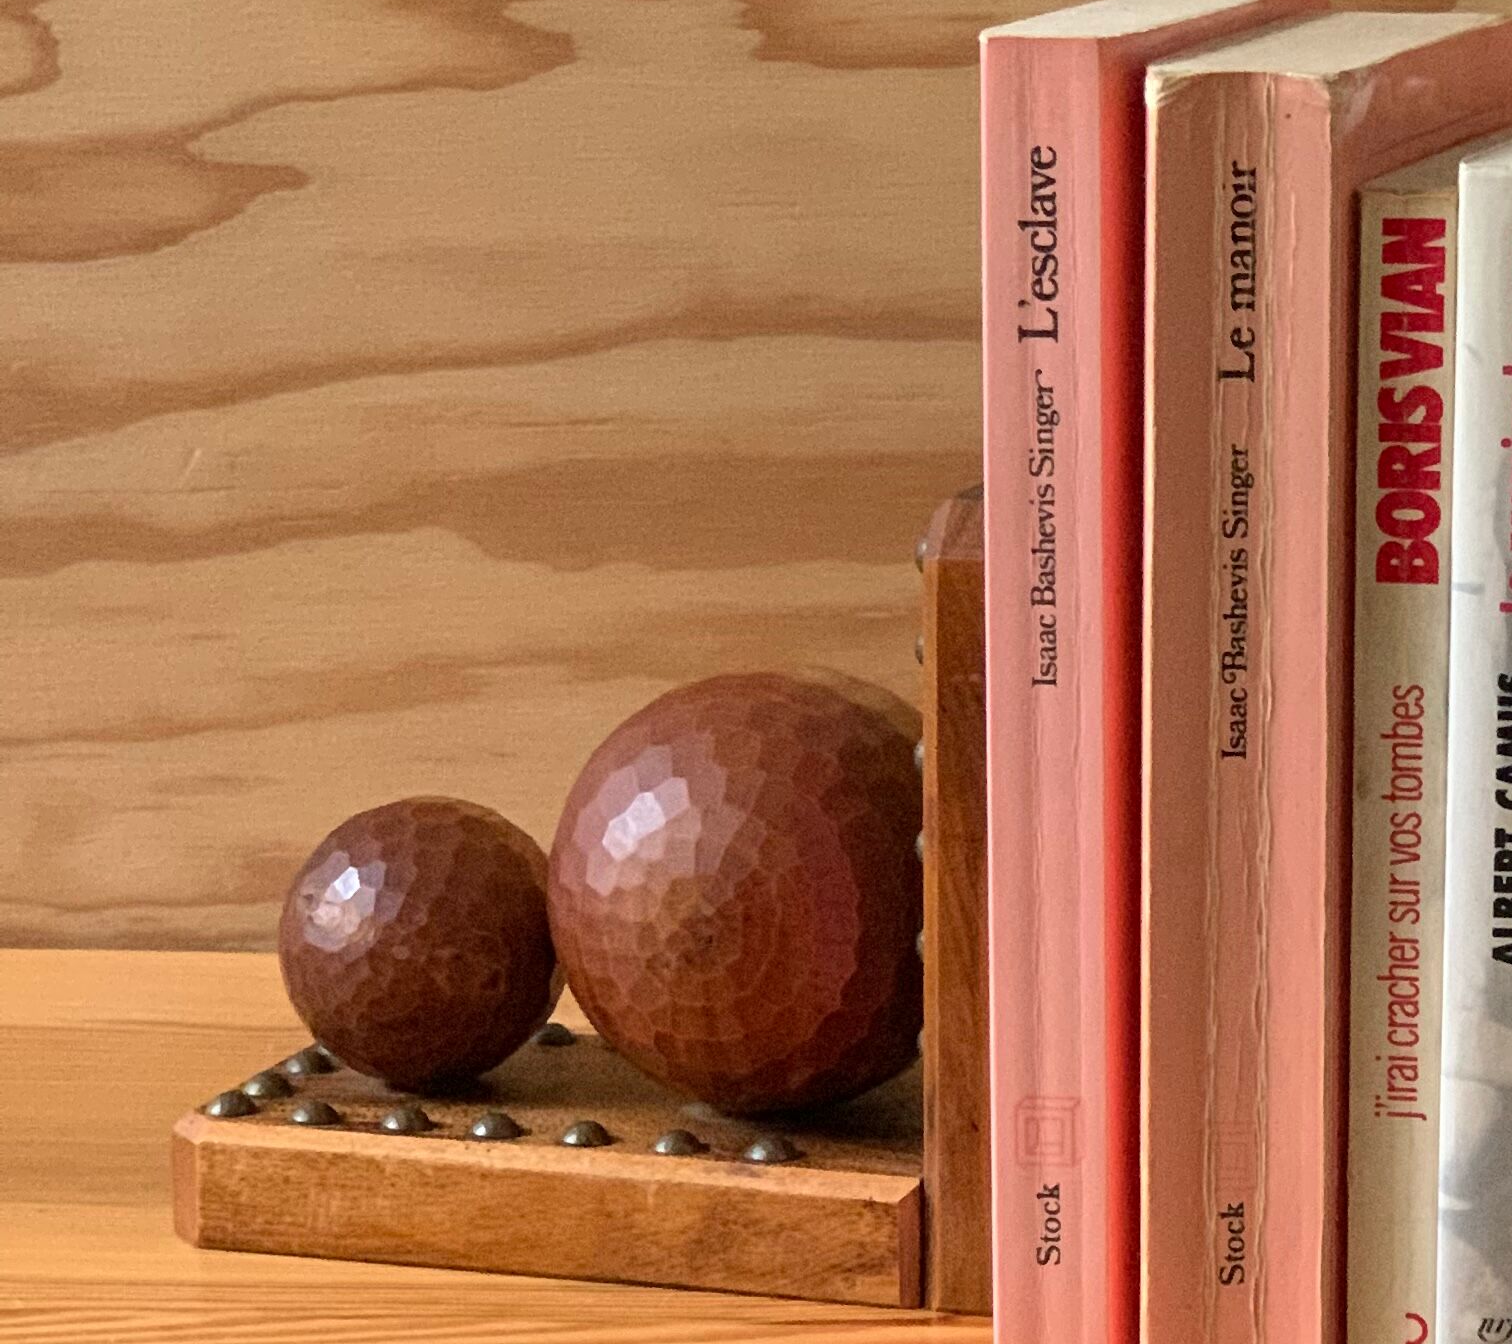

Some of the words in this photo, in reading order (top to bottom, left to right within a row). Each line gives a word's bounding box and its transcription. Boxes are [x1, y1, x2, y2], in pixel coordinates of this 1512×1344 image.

[1017, 145, 1059, 344] L'esclave
[1221, 160, 1258, 312] manoir
[1379, 217, 1447, 381] VIAN
[1218, 327, 1255, 383] Le
[1028, 369, 1062, 477] Singer
[1221, 444, 1257, 539] Singer
[1375, 385, 1444, 585] BORIS
[1029, 483, 1057, 609] Bashevis
[1031, 614, 1058, 687] Isaac
[1221, 546, 1250, 683] Bashevis
[1221, 684, 1247, 760] Isaac
[1380, 683, 1425, 804] tombes
[1389, 811, 1422, 867] vos
[1388, 872, 1420, 924] sur
[1375, 932, 1420, 1049] cracher
[1374, 1054, 1428, 1121] j'irai
[1036, 1183, 1061, 1267] Stock
[1219, 1201, 1245, 1286] Stock
